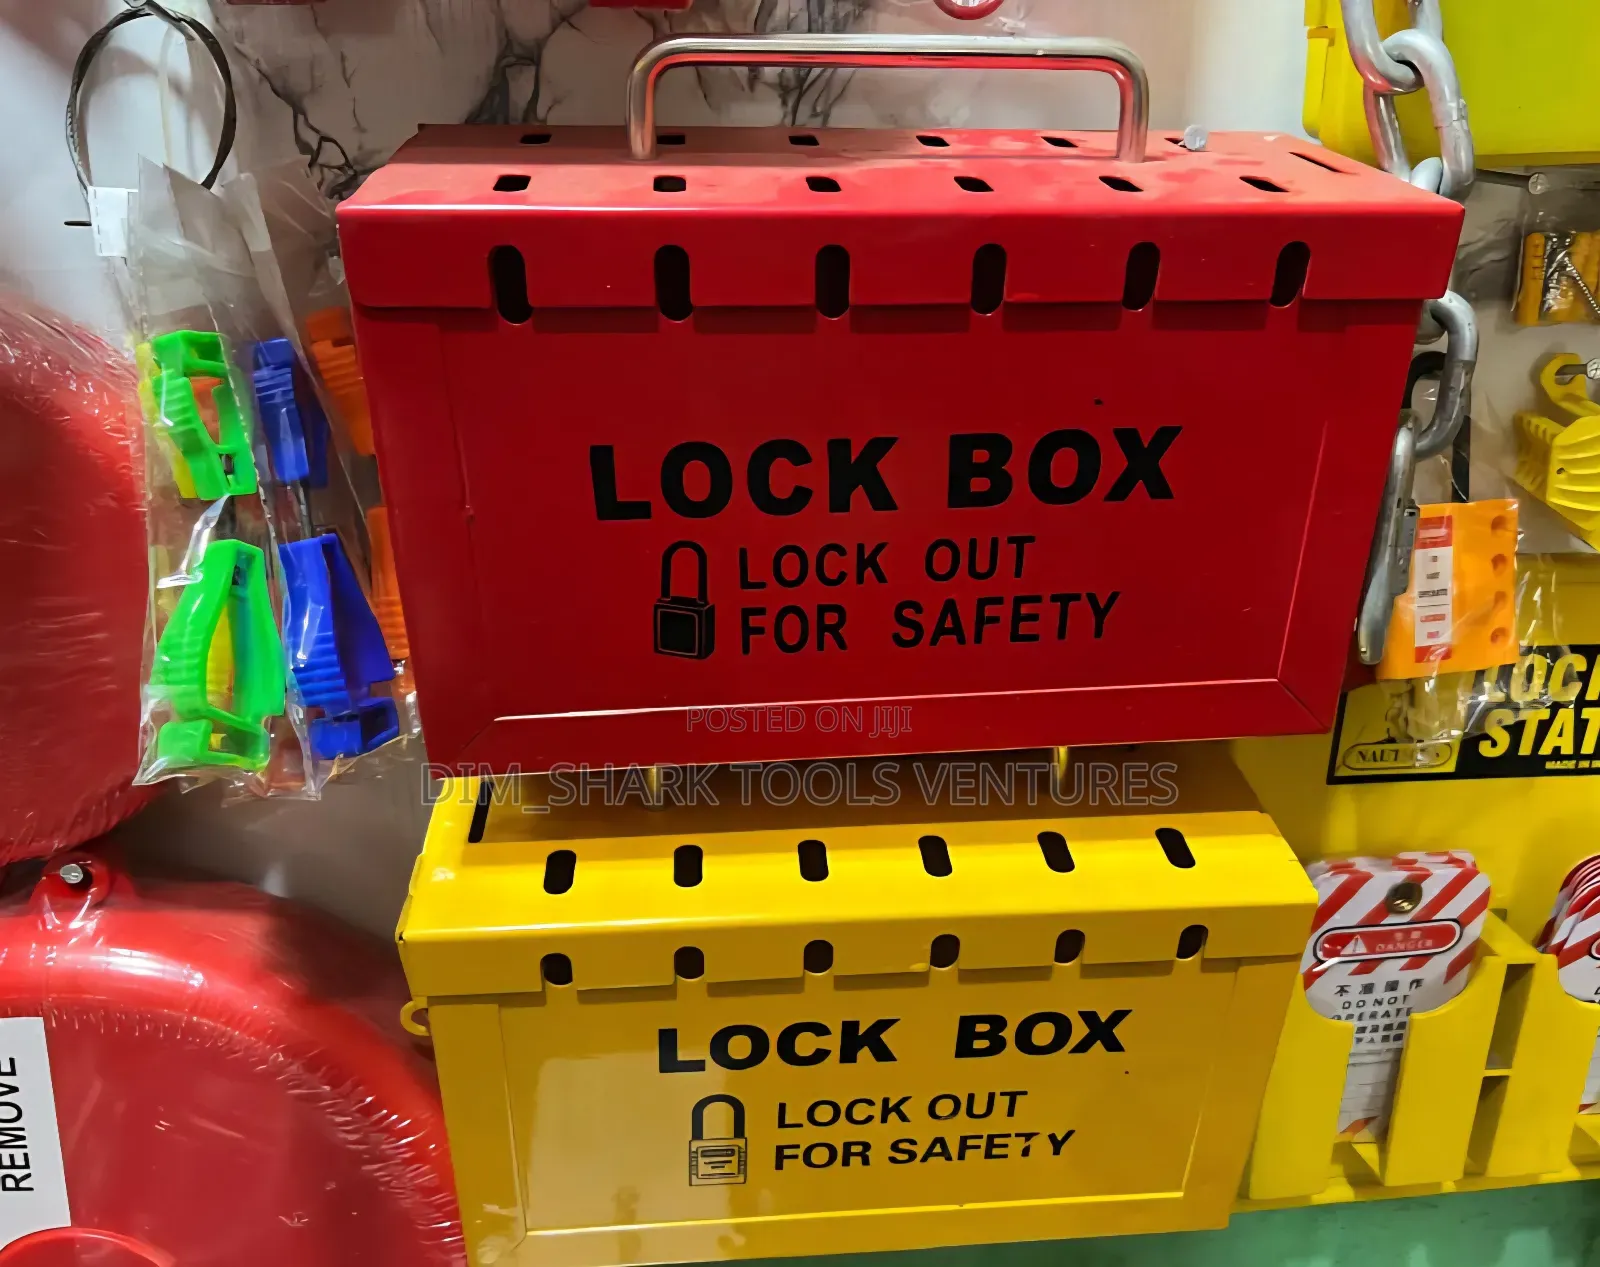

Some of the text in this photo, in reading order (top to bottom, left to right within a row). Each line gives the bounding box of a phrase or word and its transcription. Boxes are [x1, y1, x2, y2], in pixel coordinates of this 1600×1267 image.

[589, 425, 1183, 521] LOCK BOX
[738, 535, 1036, 590] LOCK OUT
[740, 591, 1121, 655] FOR SAFETY
[658, 1009, 1133, 1074] LOCK BOX
[0, 1056, 35, 1192] REMOVE
[777, 1090, 1028, 1129] LOCK OUT
[775, 1129, 1075, 1171] FOR SAFETY
